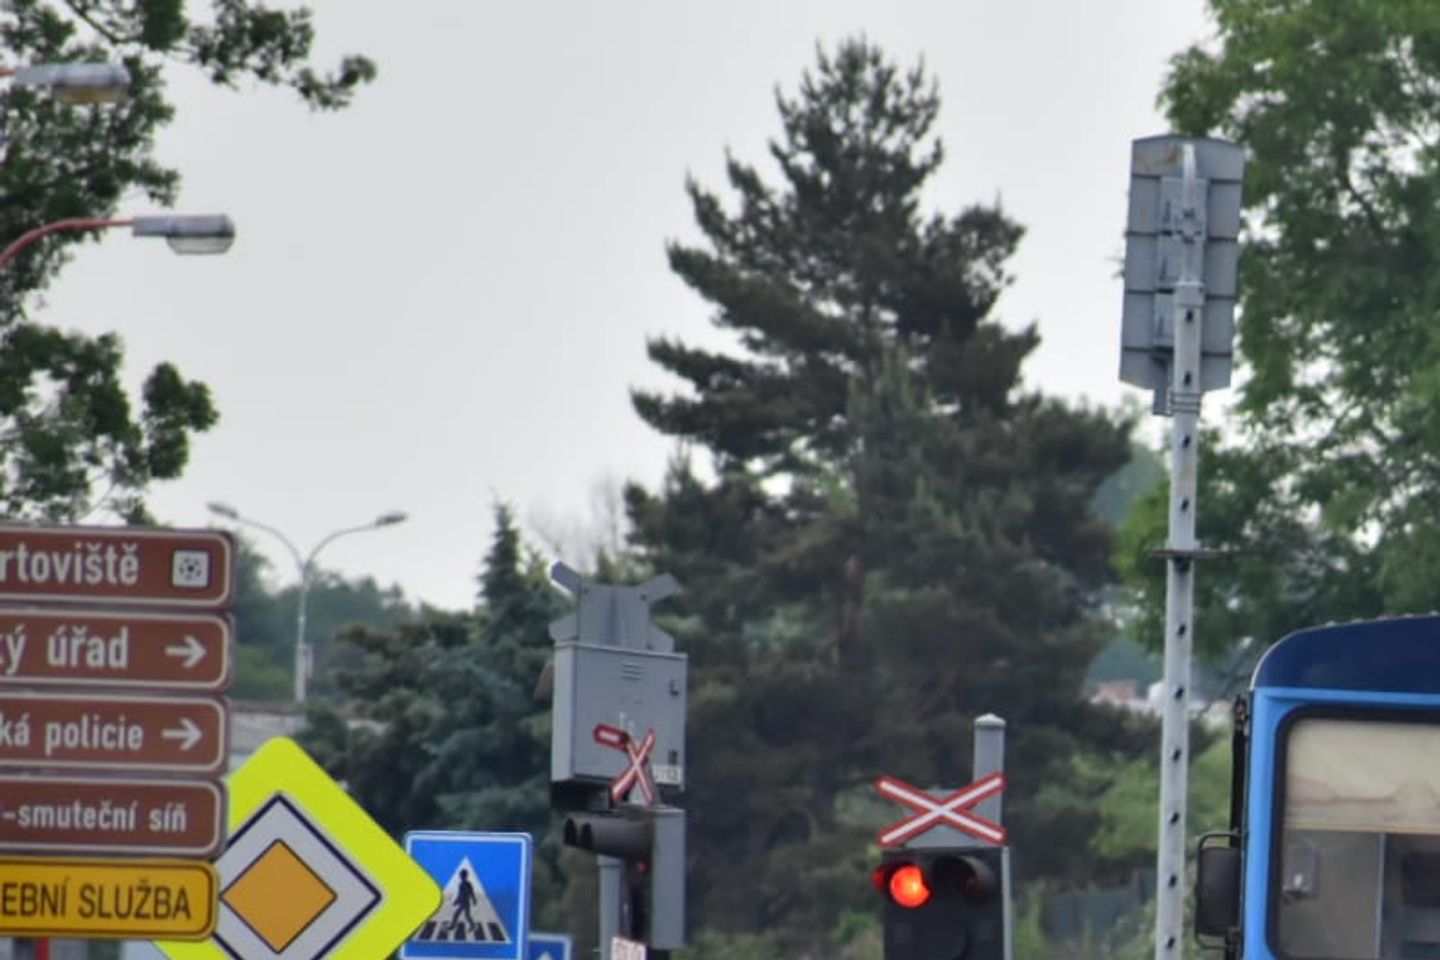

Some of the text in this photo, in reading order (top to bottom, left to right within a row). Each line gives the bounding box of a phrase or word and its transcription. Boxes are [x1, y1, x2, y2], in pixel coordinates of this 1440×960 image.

[0, 542, 139, 584] rtoviště
[47, 624, 129, 668] úřad
[45, 714, 144, 756] policie
[149, 802, 187, 832] síň
[1, 876, 192, 920] EBNÍ SLUŽBA
